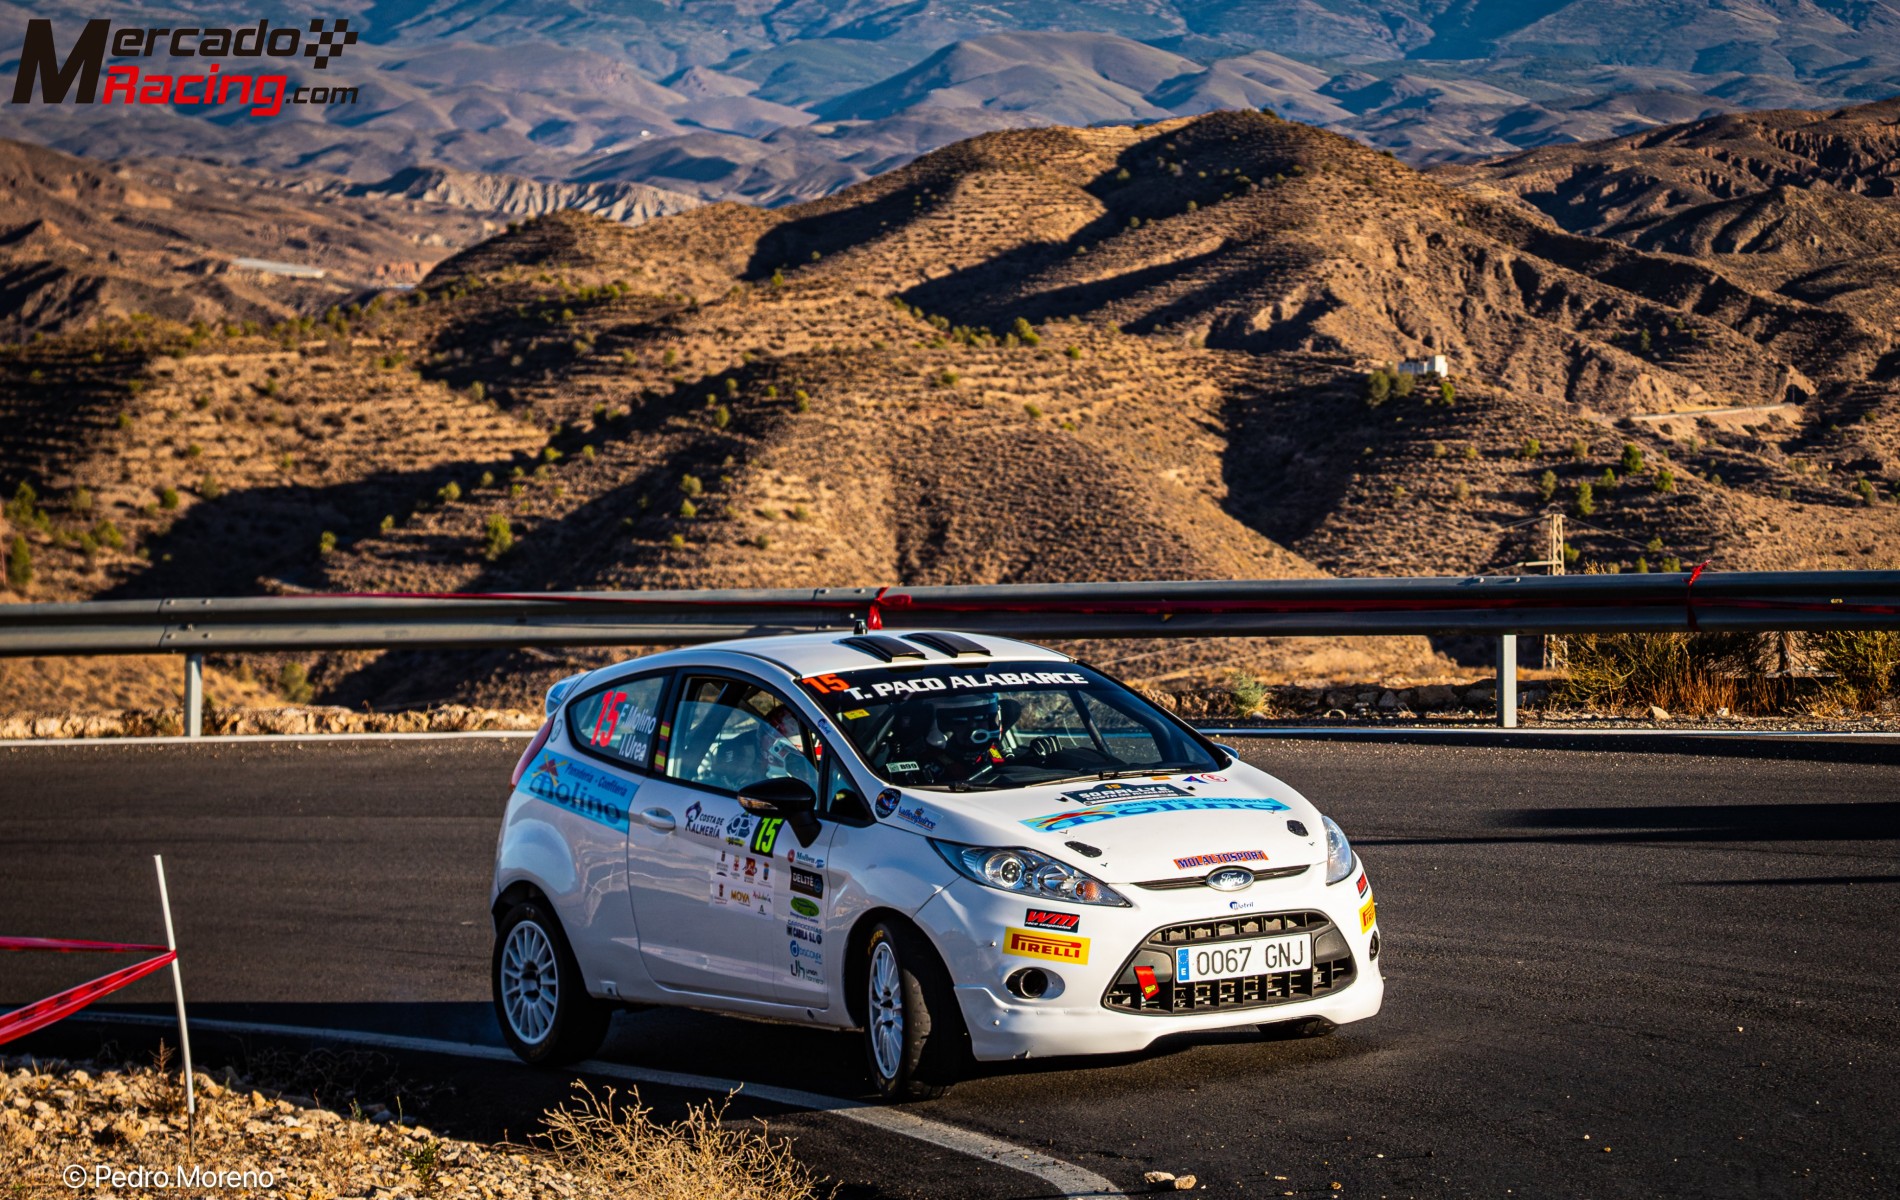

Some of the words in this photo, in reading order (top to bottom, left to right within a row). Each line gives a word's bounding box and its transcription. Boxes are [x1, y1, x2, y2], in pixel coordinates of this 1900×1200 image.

[802, 673, 850, 694] 15
[843, 687, 874, 700] T.
[871, 677, 947, 698] PACO
[950, 672, 1089, 689] ALABARCE
[590, 690, 628, 747] 15
[700, 813, 718, 824] COSTA
[717, 817, 725, 826] DE
[690, 824, 721, 839] ALMERÍA
[755, 817, 783, 854] 15
[1178, 851, 1265, 868] MOLALTOSPORT
[1220, 872, 1245, 886] Ford
[1011, 933, 1082, 958] PIRELLI
[1196, 946, 1252, 976] 0067
[1265, 940, 1304, 969] GNJ
[1180, 967, 1187, 976] E
